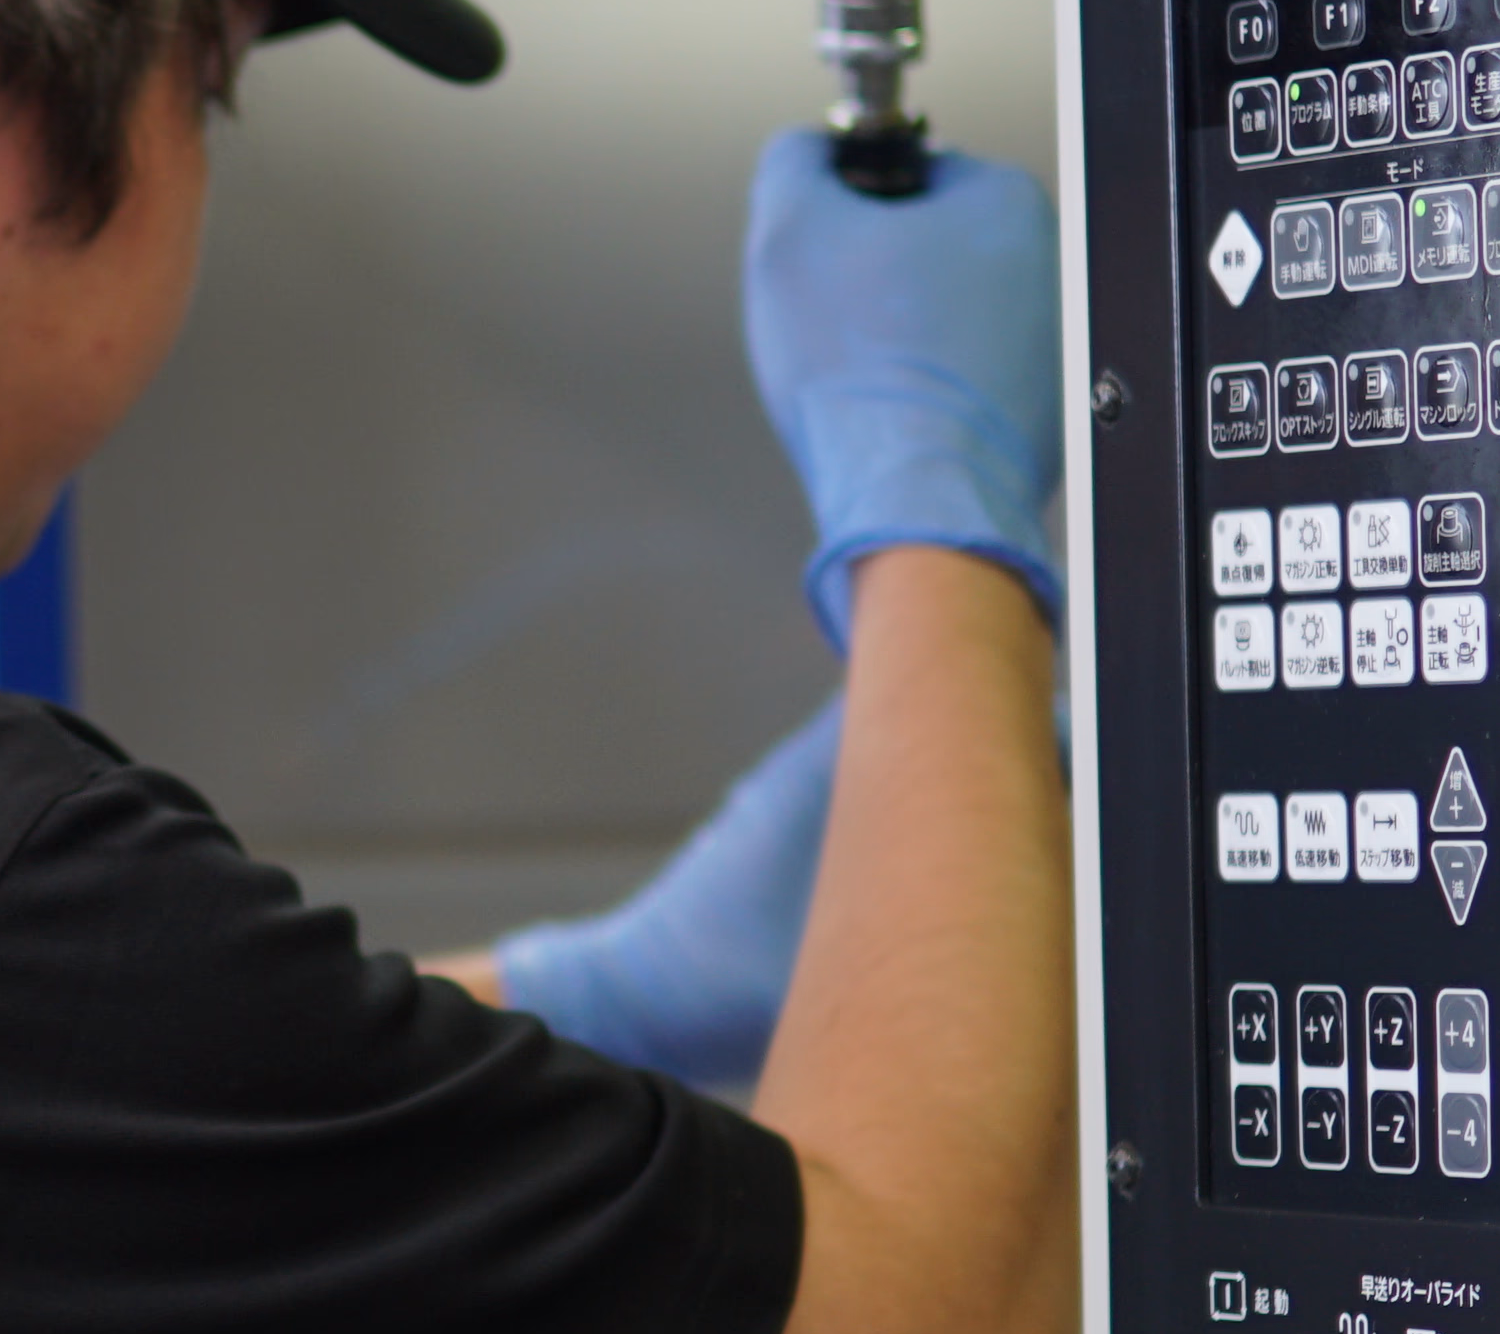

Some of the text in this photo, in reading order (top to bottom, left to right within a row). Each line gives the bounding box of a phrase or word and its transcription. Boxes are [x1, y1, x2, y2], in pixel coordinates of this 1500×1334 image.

[1325, 3, 1348, 30] F1
[1239, 18, 1263, 45] F0
[1411, 77, 1442, 101] ATC
[1475, 70, 1500, 94] 生産
[1291, 99, 1332, 126] プログラム
[1415, 101, 1440, 124] 工具
[1386, 158, 1423, 184] モード
[1348, 254, 1398, 276] MDI運転
[1417, 245, 1471, 268] メモリ運転
[1280, 259, 1327, 285] 手動運転
[1280, 412, 1334, 438] OPTストップ
[1349, 407, 1405, 431] シングル運転
[1420, 402, 1476, 424] マシンロック
[1284, 559, 1337, 579] マガジン正転
[1356, 628, 1377, 648] 主軸
[1427, 625, 1448, 645] 主軸
[1287, 656, 1341, 676] マガジン逆転
[1357, 653, 1377, 673] 停止
[1427, 650, 1450, 671] 正転
[1226, 848, 1272, 867] 高速移動
[1294, 848, 1341, 868] 低速移動
[1360, 848, 1415, 867] ステップ移動
[1236, 1013, 1267, 1042] +X
[1304, 1015, 1334, 1044] +Y
[1374, 1017, 1404, 1046] +Z
[1445, 1019, 1475, 1048] +4
[1254, 1288, 1289, 1315] 起動
[1361, 1275, 1480, 1307] 早送りオーバライド
